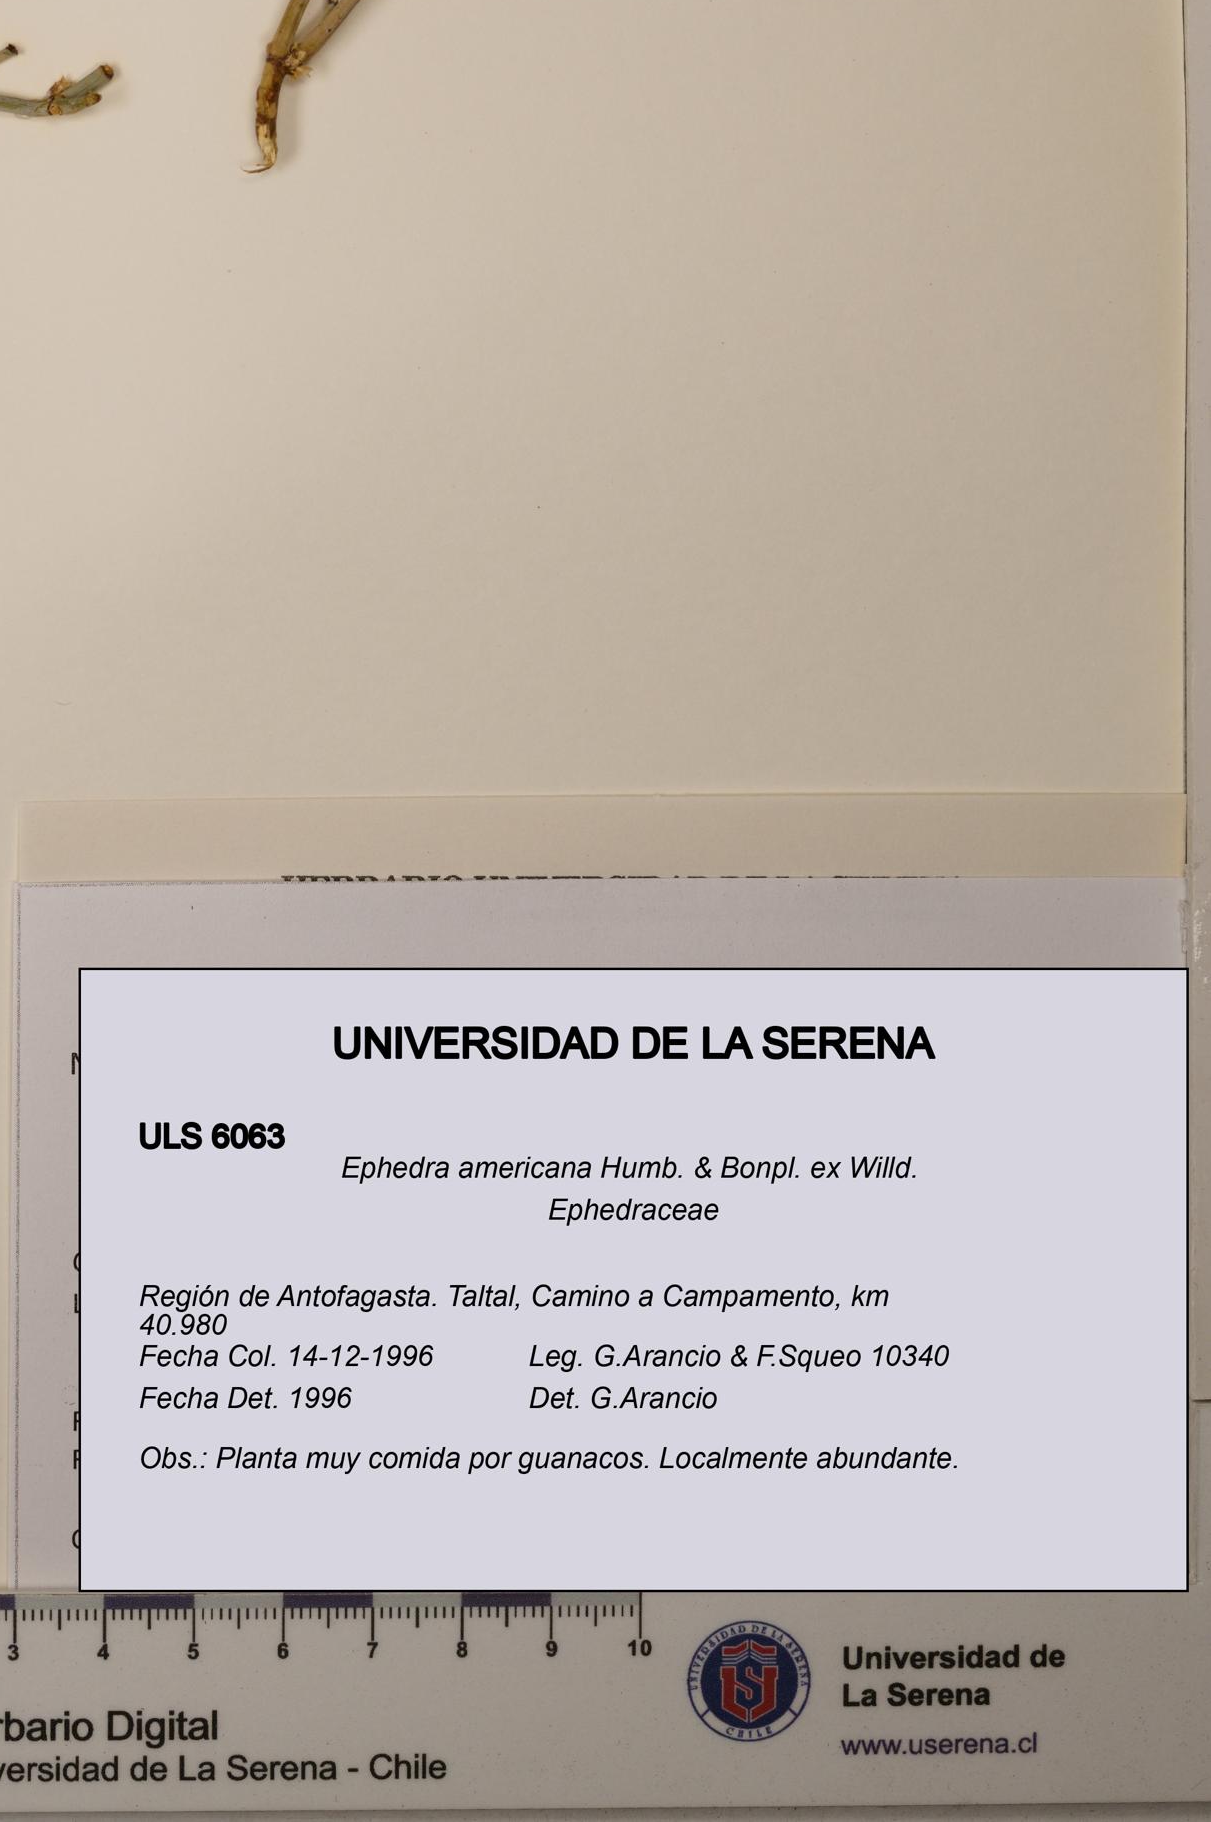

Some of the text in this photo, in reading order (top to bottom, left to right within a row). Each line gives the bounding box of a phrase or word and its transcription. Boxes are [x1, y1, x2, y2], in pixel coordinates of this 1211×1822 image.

[7, 1643, 20, 1662] 3
[96, 1643, 110, 1661] 4
[186, 1643, 200, 1661] 5
[276, 1643, 290, 1660] 6
[366, 1641, 379, 1659] 7
[455, 1641, 469, 1659] 8
[545, 1640, 559, 1658] 9
[627, 1639, 653, 1657] 10
[842, 1643, 1066, 1671] Universidad de
[842, 1681, 991, 1708] La Serena
[106, 1709, 219, 1750] Digital
[724, 1725, 774, 1739] CHILE
[840, 1731, 1038, 1756] www.userena.cl
[129, 1754, 169, 1783] de
[178, 1754, 216, 1783] La
[226, 1753, 338, 1782] Serena
[368, 1752, 448, 1781] Chile
